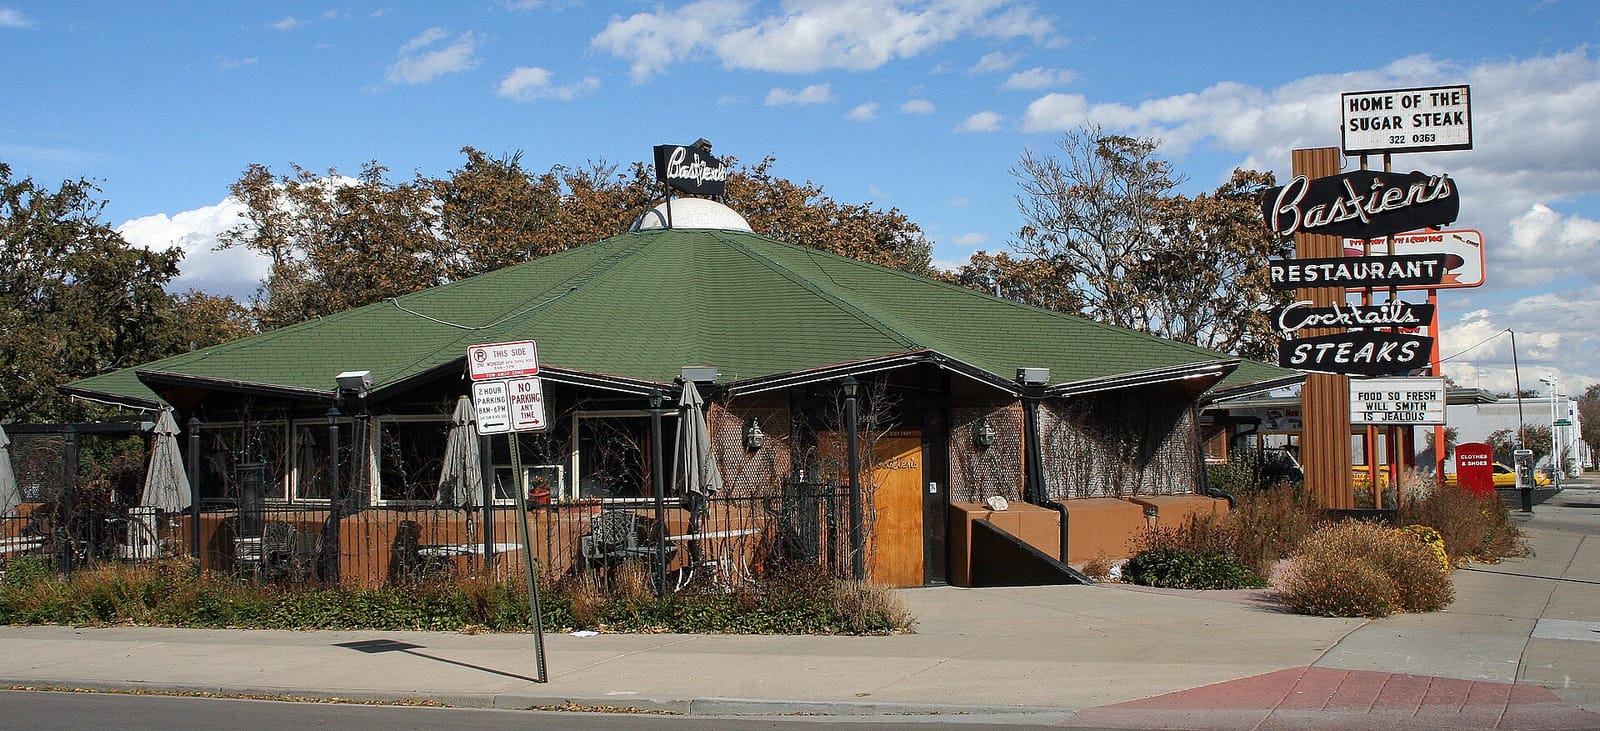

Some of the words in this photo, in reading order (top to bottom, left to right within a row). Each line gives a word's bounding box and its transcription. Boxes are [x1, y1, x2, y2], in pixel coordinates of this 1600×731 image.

[1349, 96, 1393, 112] HOME
[1401, 95, 1421, 109] OF
[1430, 91, 1460, 107] THE
[1349, 116, 1403, 132] SUGAR
[1412, 111, 1464, 128] STEAK
[1389, 135, 1406, 144] 322
[1412, 134, 1436, 143] 0363
[1271, 174, 1450, 236] Bastien's
[1271, 260, 1438, 283] RESTAURANT
[1278, 299, 1420, 332] Cocktails
[492, 349, 508, 358] THIS
[511, 347, 527, 357] SIDE
[1290, 341, 1420, 364] STEAKS
[484, 386, 502, 395] HOUR
[518, 382, 531, 392] NO
[477, 396, 506, 405] PARKING
[511, 393, 540, 404] PARKING
[1358, 391, 1382, 401] FOOD
[1388, 391, 1400, 401] SO
[1407, 391, 1436, 401] FRESH
[1366, 402, 1389, 411] WILL
[1395, 402, 1427, 411] SMITH
[521, 411, 536, 419] TIME
[1363, 412, 1373, 420] IS
[1382, 412, 1425, 420] JEALOUS
